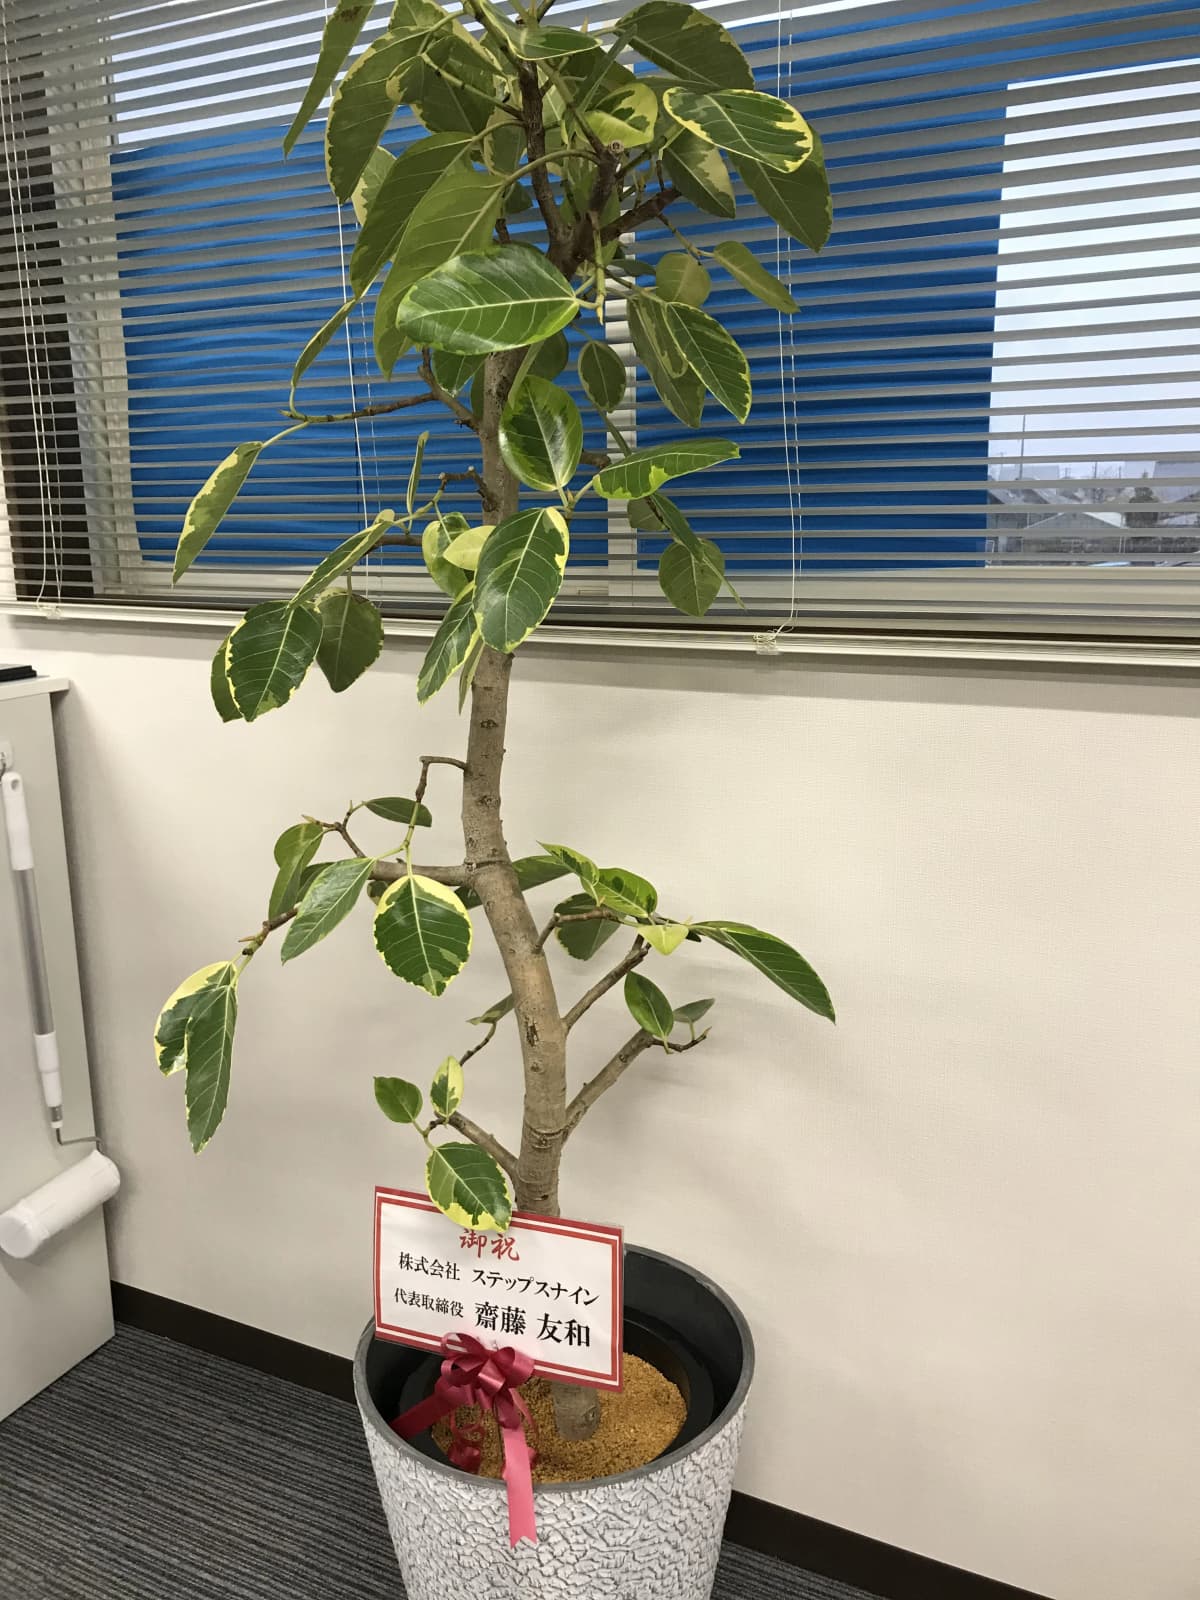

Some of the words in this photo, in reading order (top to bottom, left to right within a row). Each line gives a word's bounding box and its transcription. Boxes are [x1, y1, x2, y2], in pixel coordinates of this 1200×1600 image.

[459, 1228, 520, 1261] 御祝
[398, 1251, 461, 1281] 株式会社
[471, 1269, 600, 1306] ステップスナイン
[394, 1287, 464, 1318] 代表取締役
[536, 1312, 590, 1347] 友和
